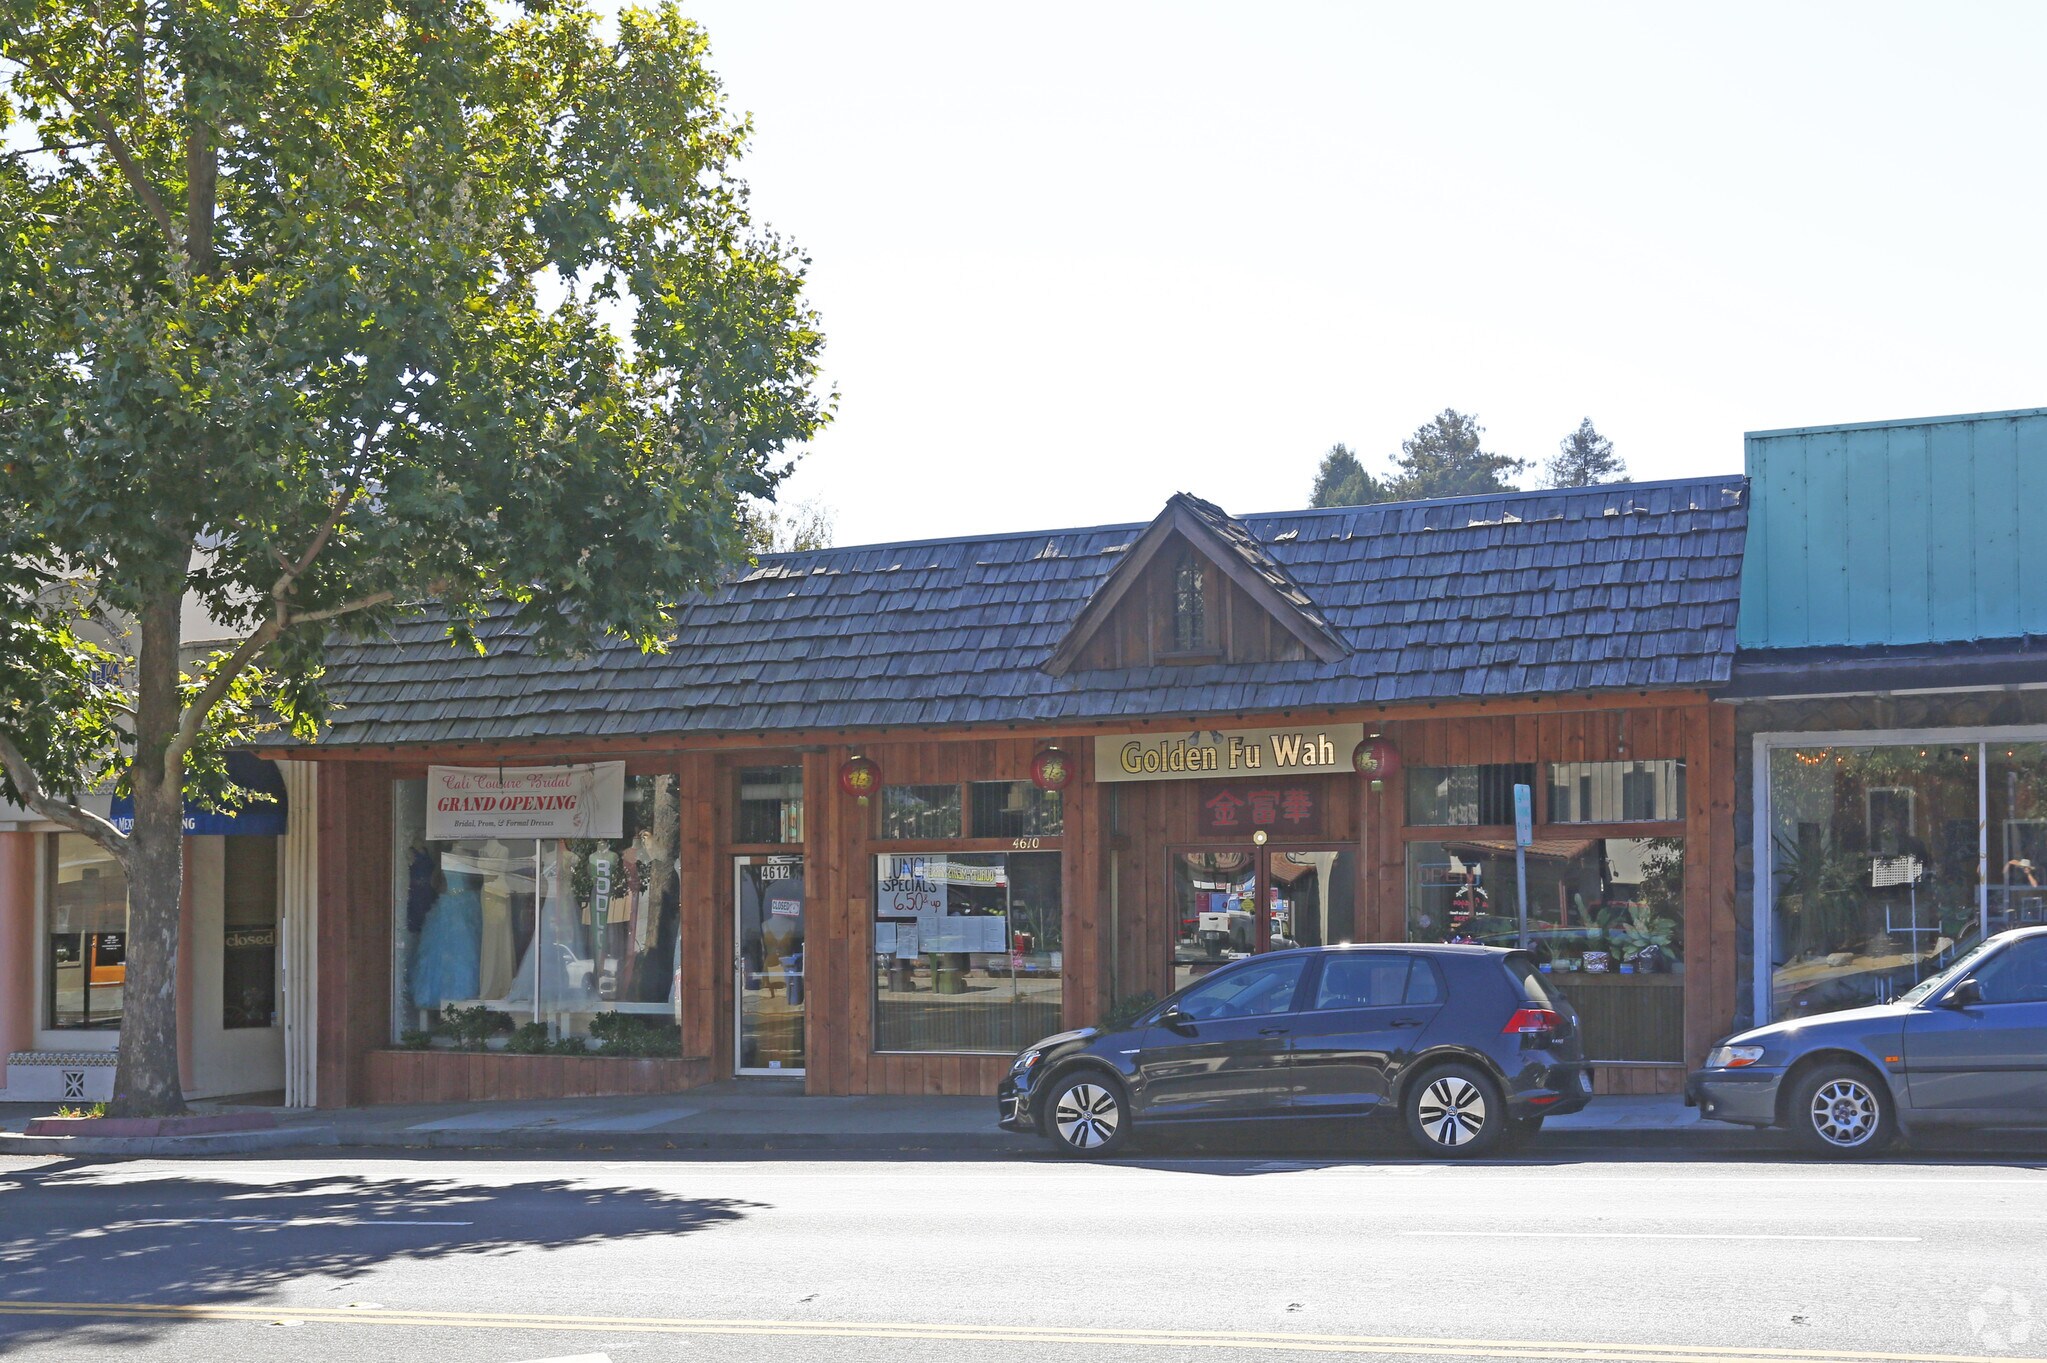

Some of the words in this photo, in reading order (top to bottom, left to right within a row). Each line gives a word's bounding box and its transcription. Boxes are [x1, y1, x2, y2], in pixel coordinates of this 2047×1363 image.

[1120, 739, 1218, 773] Golden
[1228, 736, 1261, 769] Fu
[1269, 733, 1335, 768] Wah
[442, 775, 471, 790] Cali
[526, 773, 572, 788] Bridal
[437, 796, 496, 812] GRAND
[499, 795, 577, 812] OPENING
[1206, 788, 1313, 826] 金富華
[454, 819, 476, 828] Bridal,
[498, 819, 504, 827] &
[505, 819, 529, 827] Formal
[530, 819, 554, 827] Dresses
[1012, 837, 1040, 849] 4610
[762, 866, 789, 879] 4612
[882, 879, 937, 893] SPECIALS
[930, 900, 941, 913] up
[226, 932, 274, 947] closed
